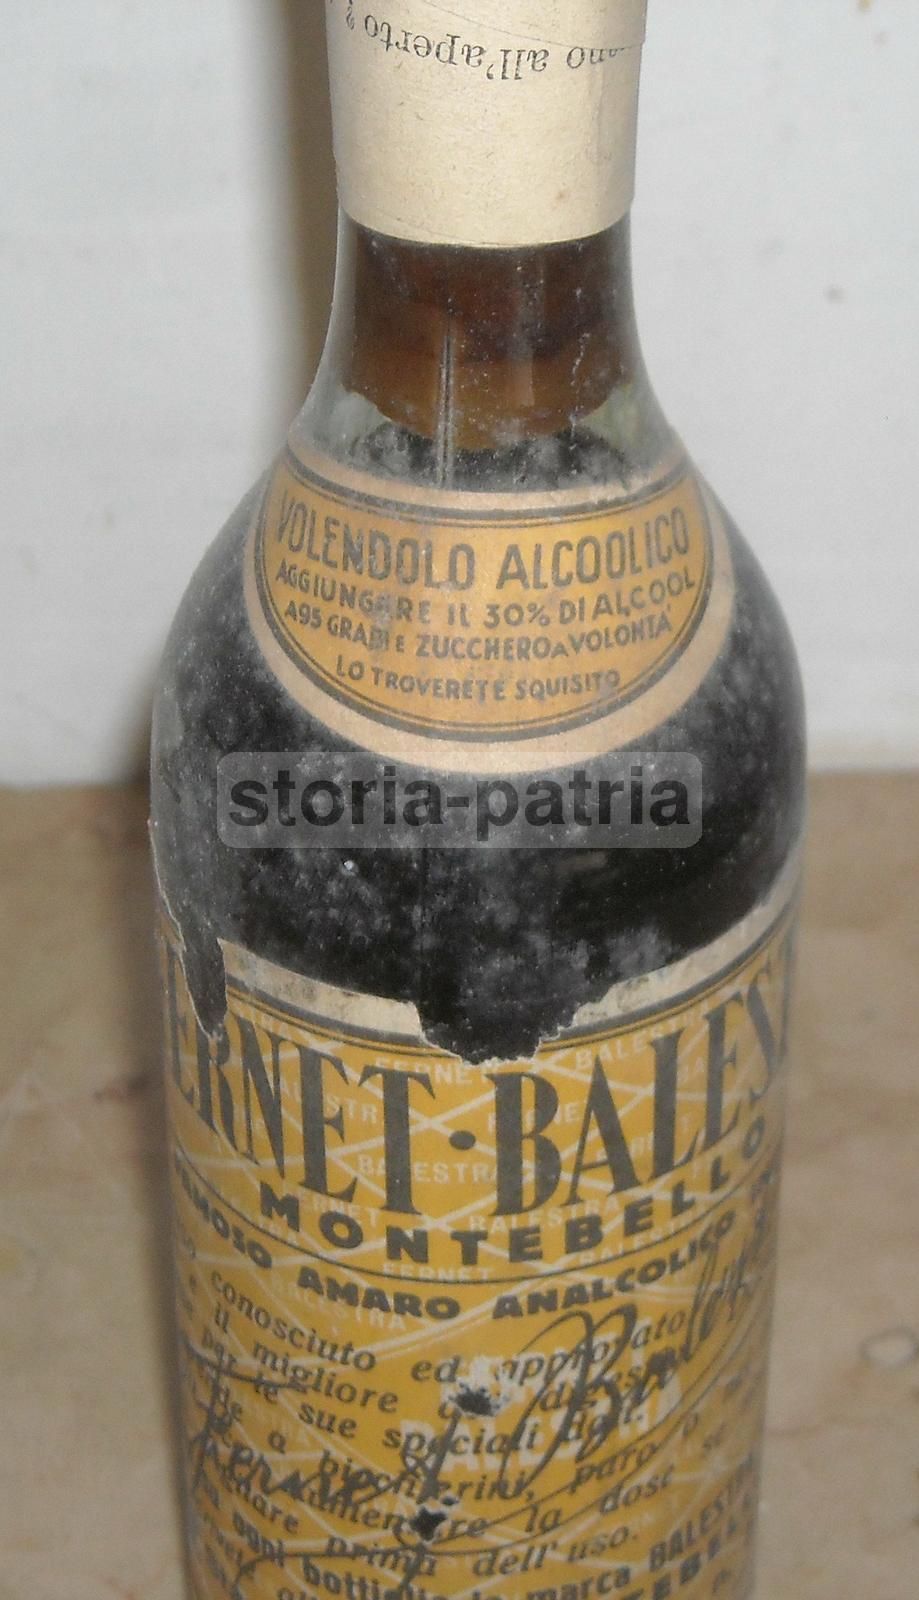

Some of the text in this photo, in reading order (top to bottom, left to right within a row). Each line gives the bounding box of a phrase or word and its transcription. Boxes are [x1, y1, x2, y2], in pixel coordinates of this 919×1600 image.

[364, 14, 550, 80] all'aperto
[277, 491, 690, 590] VOLENDOLO ALCOOLICO
[448, 606, 470, 628] IL
[486, 602, 551, 629] 30%
[559, 597, 585, 624] DI
[591, 566, 696, 619] ALCOOL
[335, 655, 621, 703] LO TROVERETE SQUISITO
[260, 1114, 765, 1270] MONTEBELLO
[298, 1265, 461, 1320] AMARO
[492, 1208, 736, 1320] ANALCOLICO
[211, 1270, 376, 1372] conosciuto
[411, 1354, 460, 1384] ed
[253, 1338, 398, 1415] migliore
[298, 1401, 357, 1438] sue
